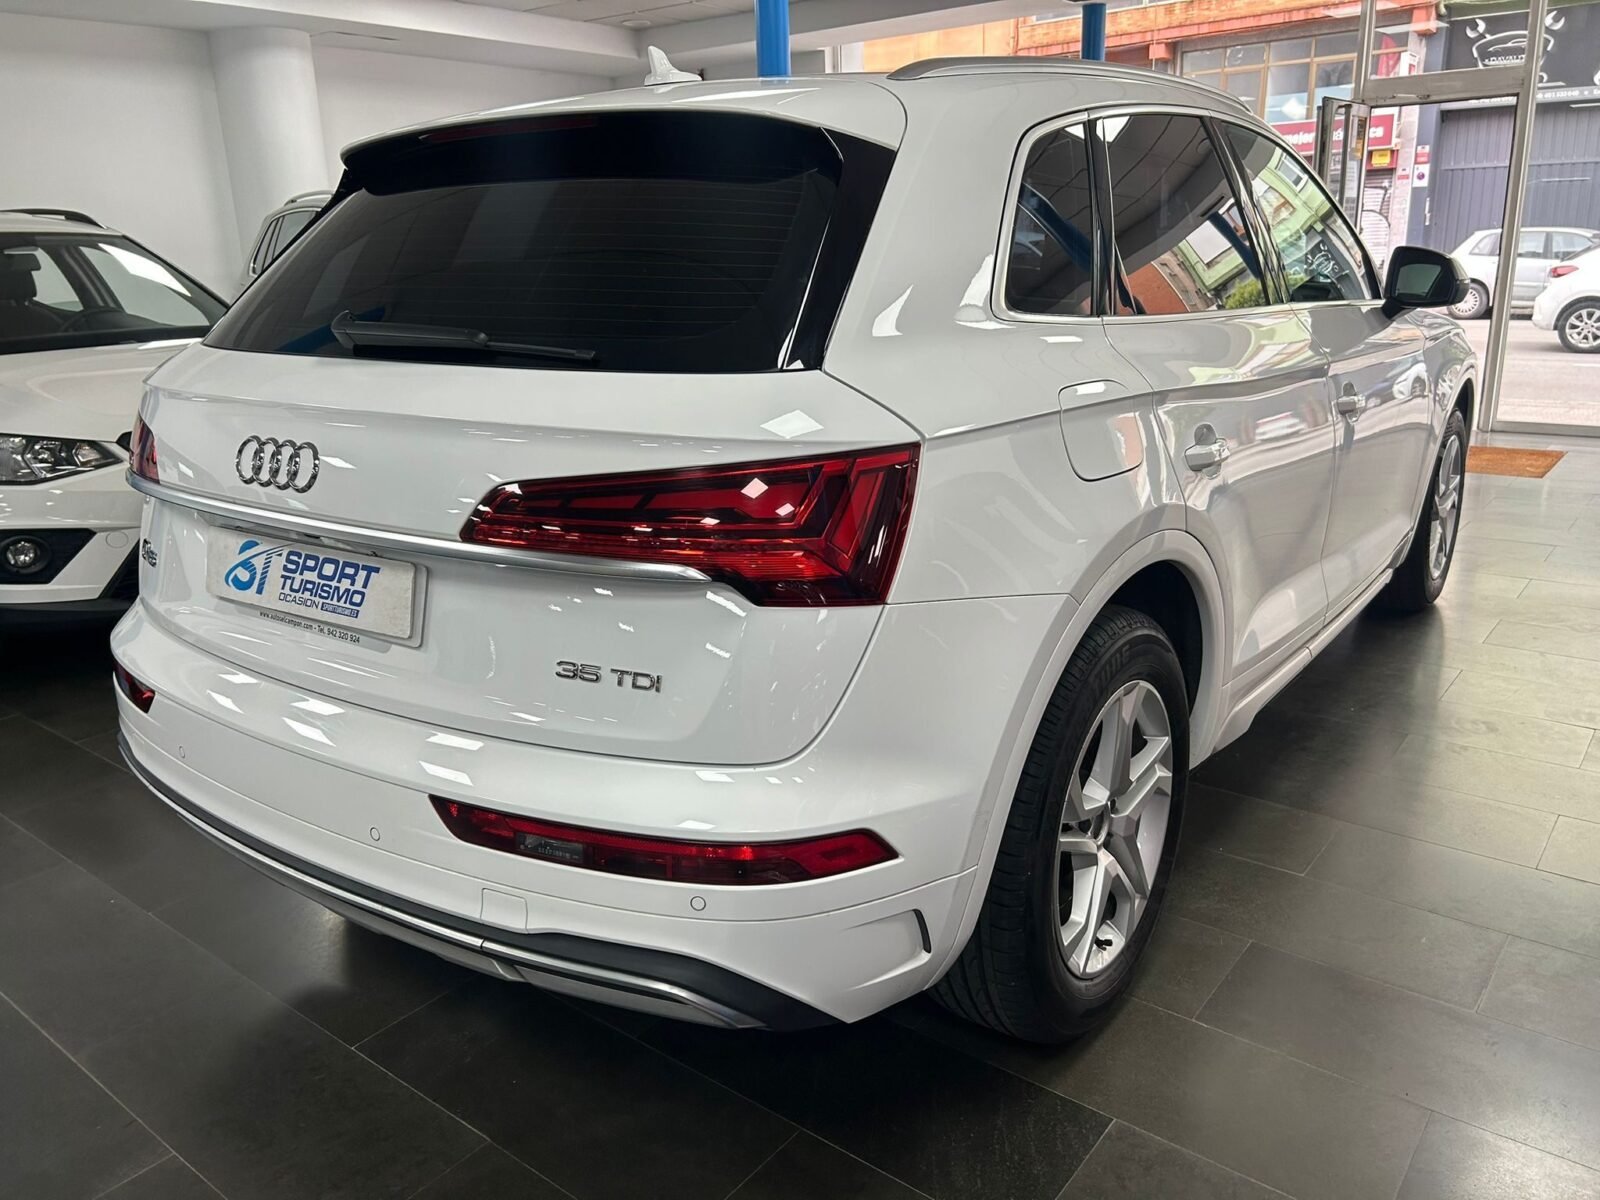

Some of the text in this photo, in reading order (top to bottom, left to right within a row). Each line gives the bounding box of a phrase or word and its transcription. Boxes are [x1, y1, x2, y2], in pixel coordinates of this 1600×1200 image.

[282, 550, 381, 590] SPORT
[278, 592, 320, 609] OCASION
[279, 574, 366, 608] TURISMO
[317, 625, 326, 634] Tel.
[327, 628, 338, 638] 942
[338, 631, 348, 641] 320
[350, 634, 360, 643] 924
[555, 660, 662, 693] 35 TDI
